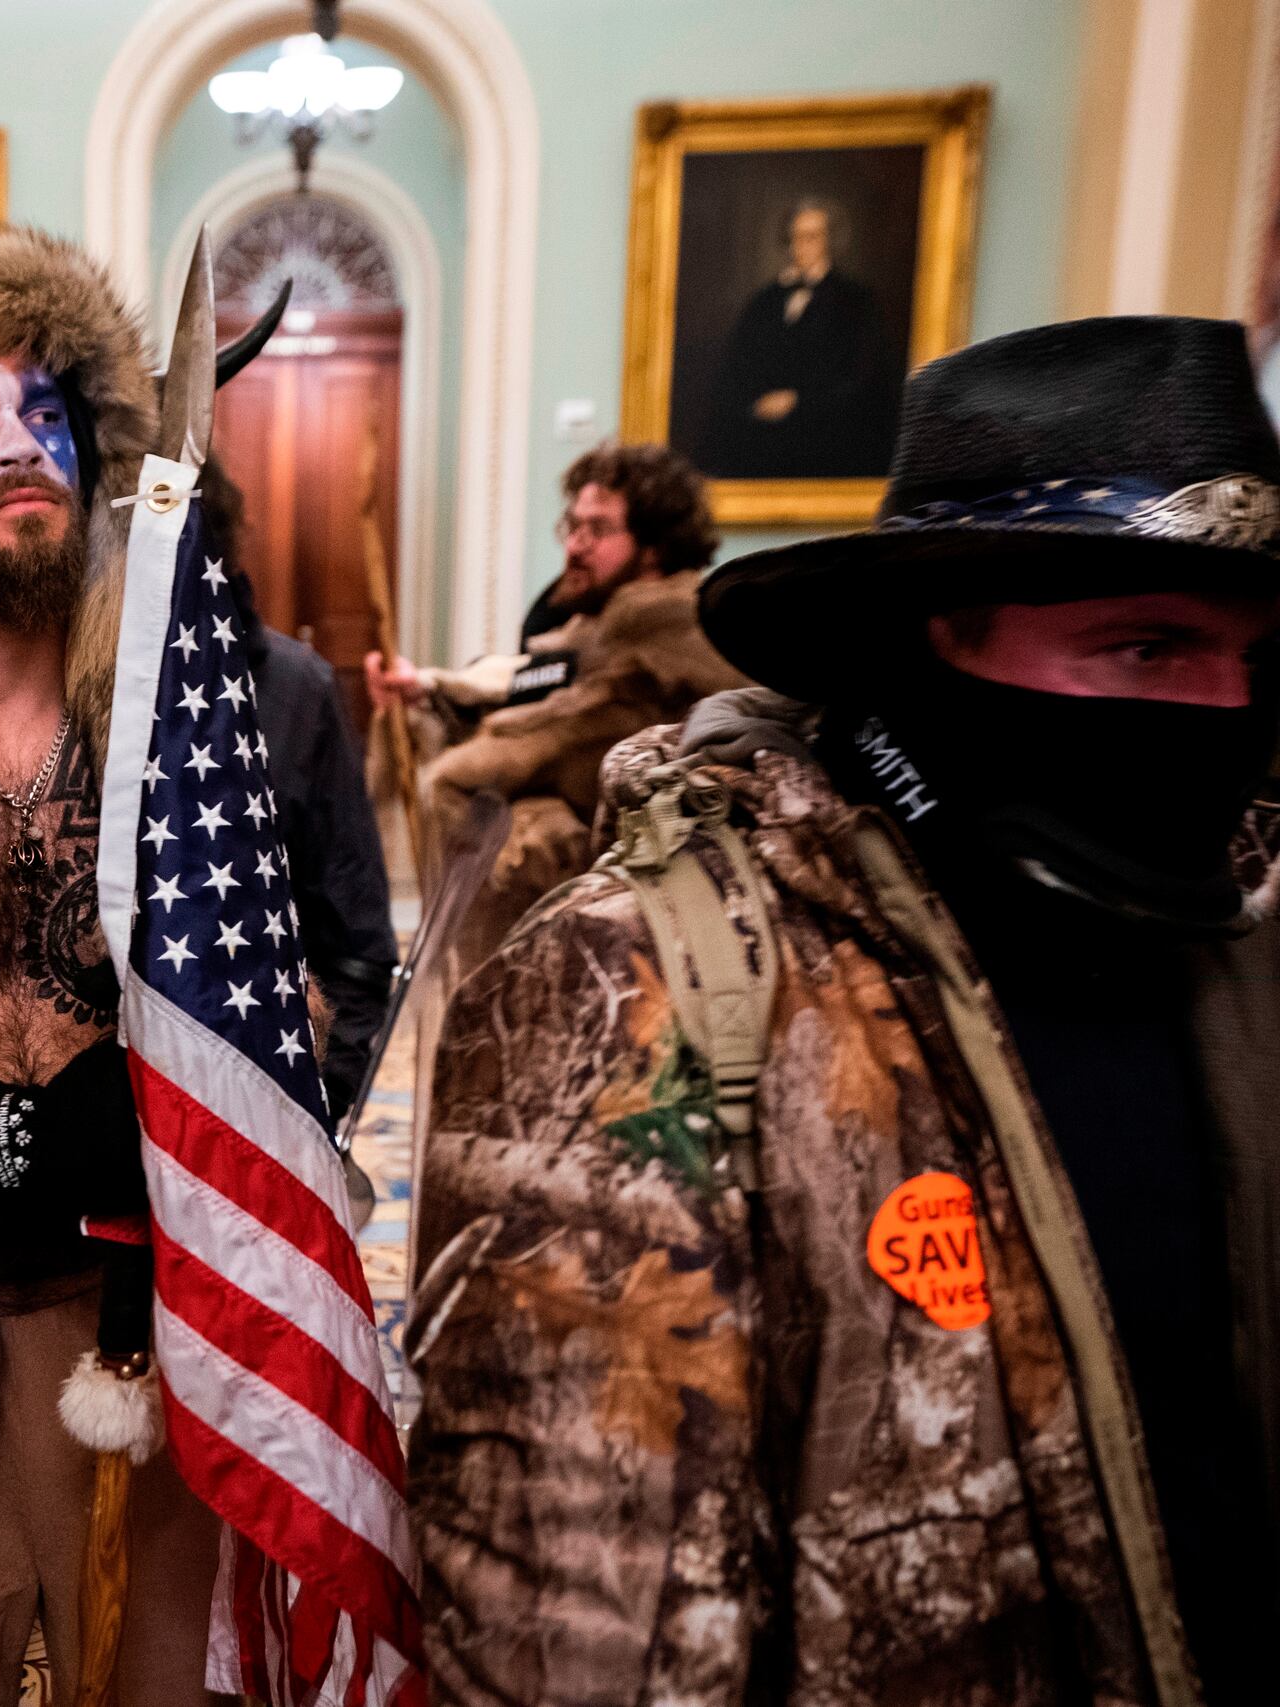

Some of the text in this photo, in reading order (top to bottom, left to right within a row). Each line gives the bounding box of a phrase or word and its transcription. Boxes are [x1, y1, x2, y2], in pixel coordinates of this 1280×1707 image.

[854, 716, 938, 822] SMITH
[0, 1092, 15, 1105] THE
[1, 1148, 20, 1188] SOCIETY
[883, 1228, 973, 1275] SAV
